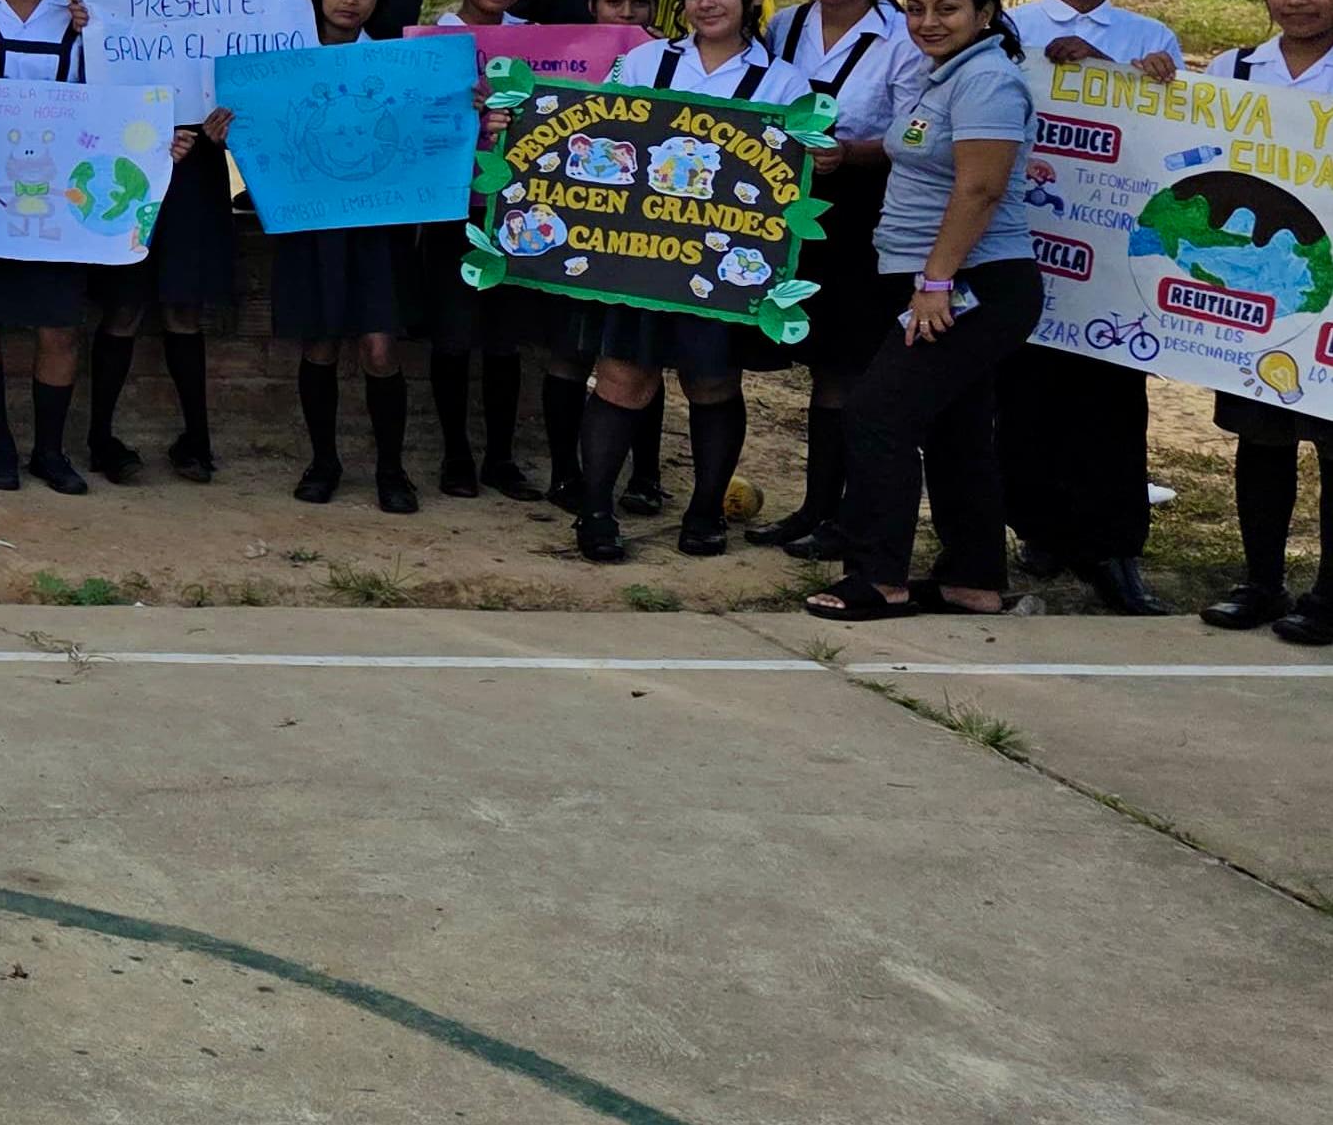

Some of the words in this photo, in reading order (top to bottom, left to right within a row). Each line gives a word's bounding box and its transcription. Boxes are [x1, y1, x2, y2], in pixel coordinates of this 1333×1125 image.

[104, 34, 175, 61] SALVA
[185, 34, 213, 59] EL
[226, 30, 305, 56] FUTURO
[1050, 62, 1272, 139] CONSERVA
[1309, 99, 1333, 149] Y
[505, 94, 653, 172] PEQUEÑAS
[671, 106, 800, 205] ACCIONES
[525, 178, 629, 214] HACEN
[641, 195, 788, 242] GRANDES
[1090, 189, 1101, 201] A
[1111, 192, 1129, 207] LO
[568, 225, 704, 266] CAMBIOS
[1033, 238, 1086, 273] CICLA
[1170, 286, 1264, 326] REUTILIZA
[1160, 314, 1205, 336] EVITA
[1215, 329, 1244, 344] LOS
